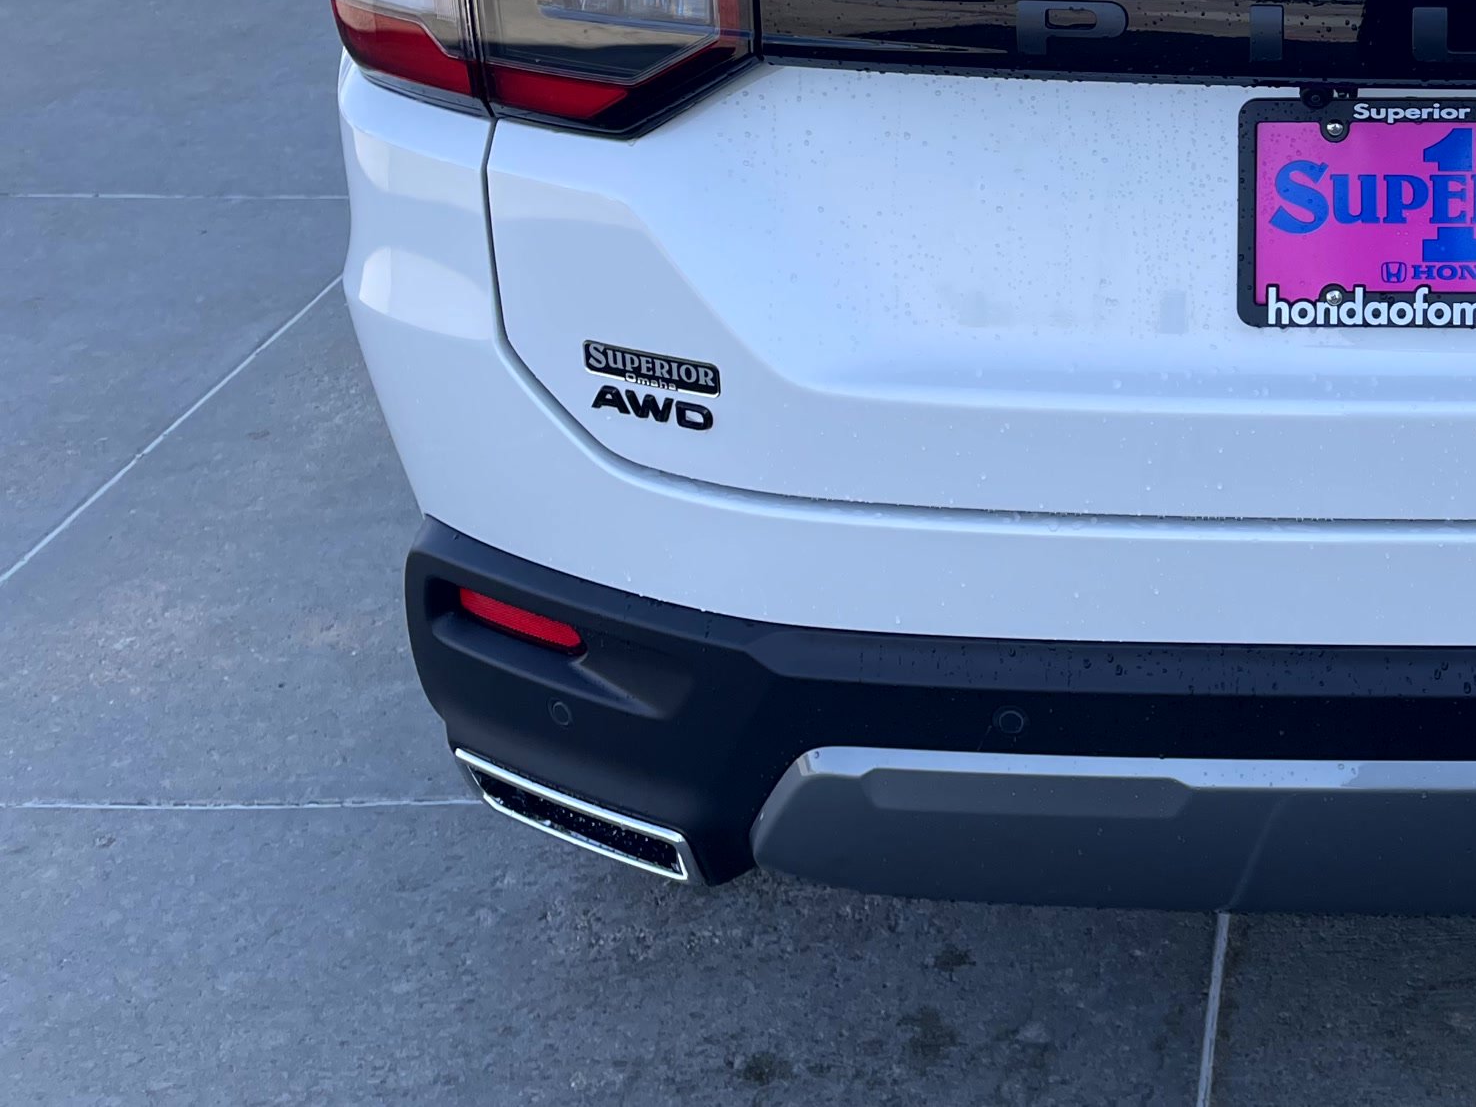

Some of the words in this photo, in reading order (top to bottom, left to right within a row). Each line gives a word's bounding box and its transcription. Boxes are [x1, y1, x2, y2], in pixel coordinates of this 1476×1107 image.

[1353, 103, 1471, 123] Superior
[588, 343, 716, 387] SUPERIOR
[624, 372, 678, 392] Omaha
[591, 384, 714, 431] AWD
